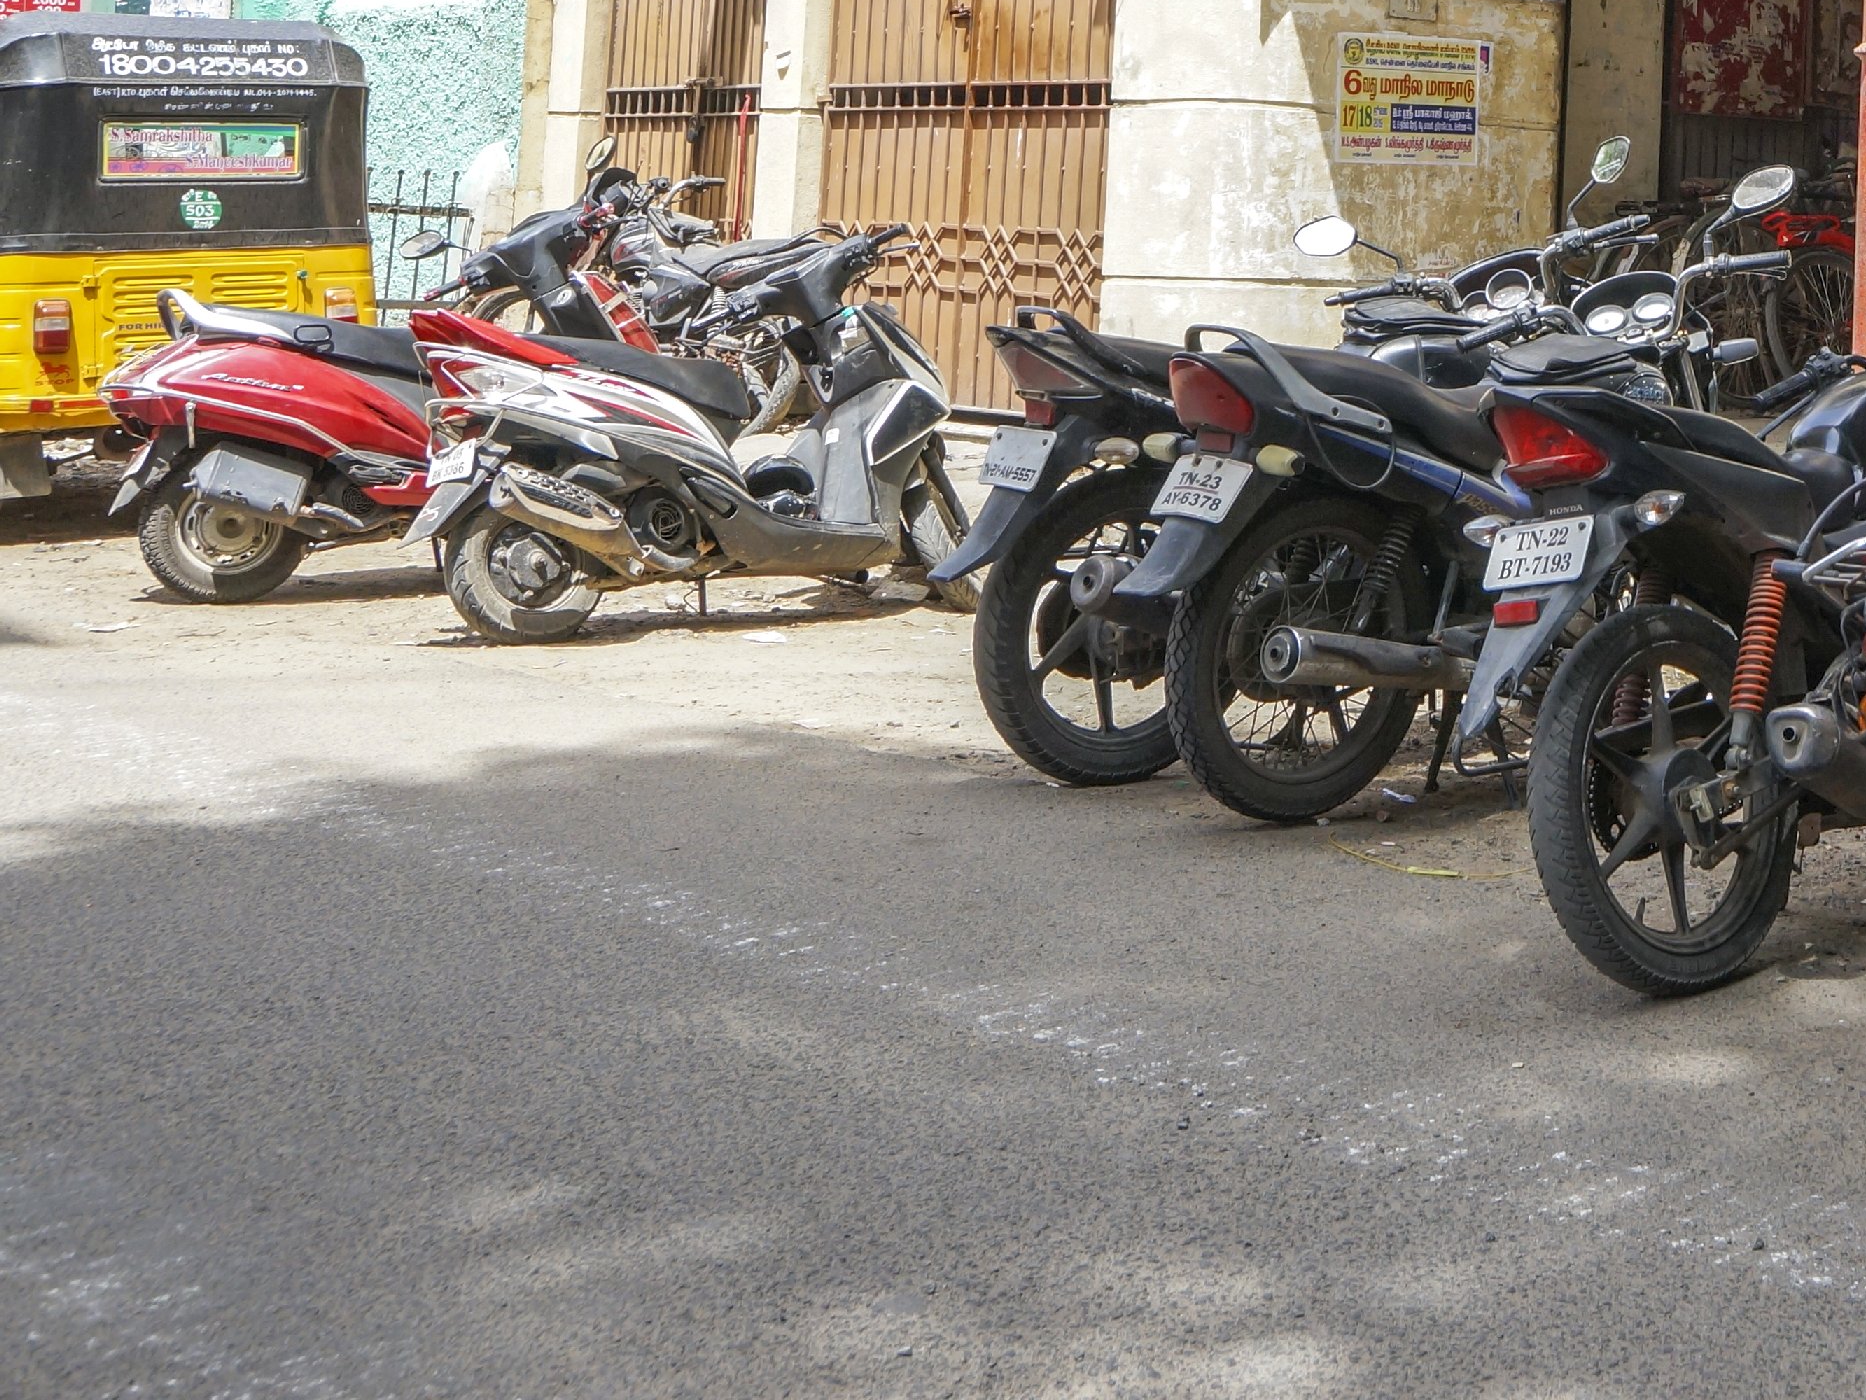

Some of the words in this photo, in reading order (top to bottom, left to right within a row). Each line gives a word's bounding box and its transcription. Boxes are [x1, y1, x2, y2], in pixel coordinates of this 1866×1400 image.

[99, 54, 308, 77] 18004255430
[1380, 73, 1423, 100] மாநில
[1426, 79, 1475, 103] மாநாடு
[186, 205, 214, 217] 503
[119, 323, 143, 331] FOR
[1179, 472, 1222, 489] TN-23
[1162, 492, 1222, 512] AY-6378
[1549, 504, 1584, 516] HONDA
[1516, 526, 1569, 551] TN-22
[1497, 553, 1572, 580] BT-7193
